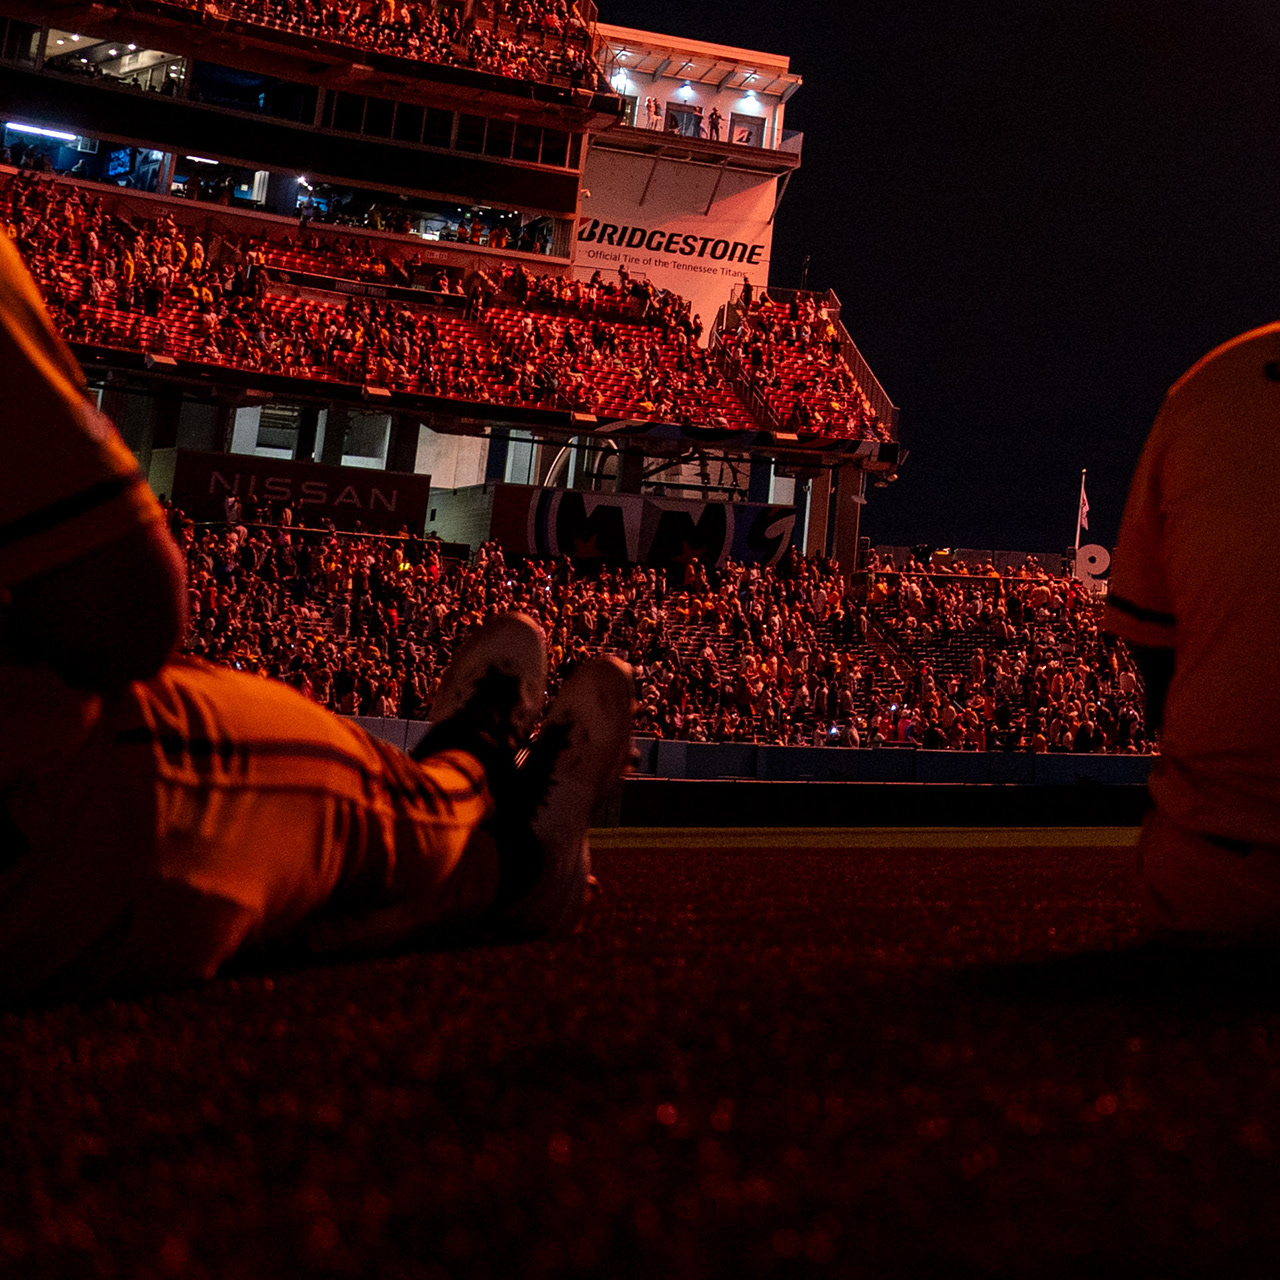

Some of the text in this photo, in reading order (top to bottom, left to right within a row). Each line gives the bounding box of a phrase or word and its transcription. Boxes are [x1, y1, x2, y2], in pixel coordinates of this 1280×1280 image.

[577, 217, 765, 265] BRIDGESTONE
[588, 250, 747, 278] Official Tire of the Tennessee Titans
[209, 471, 398, 512] NISSAN
